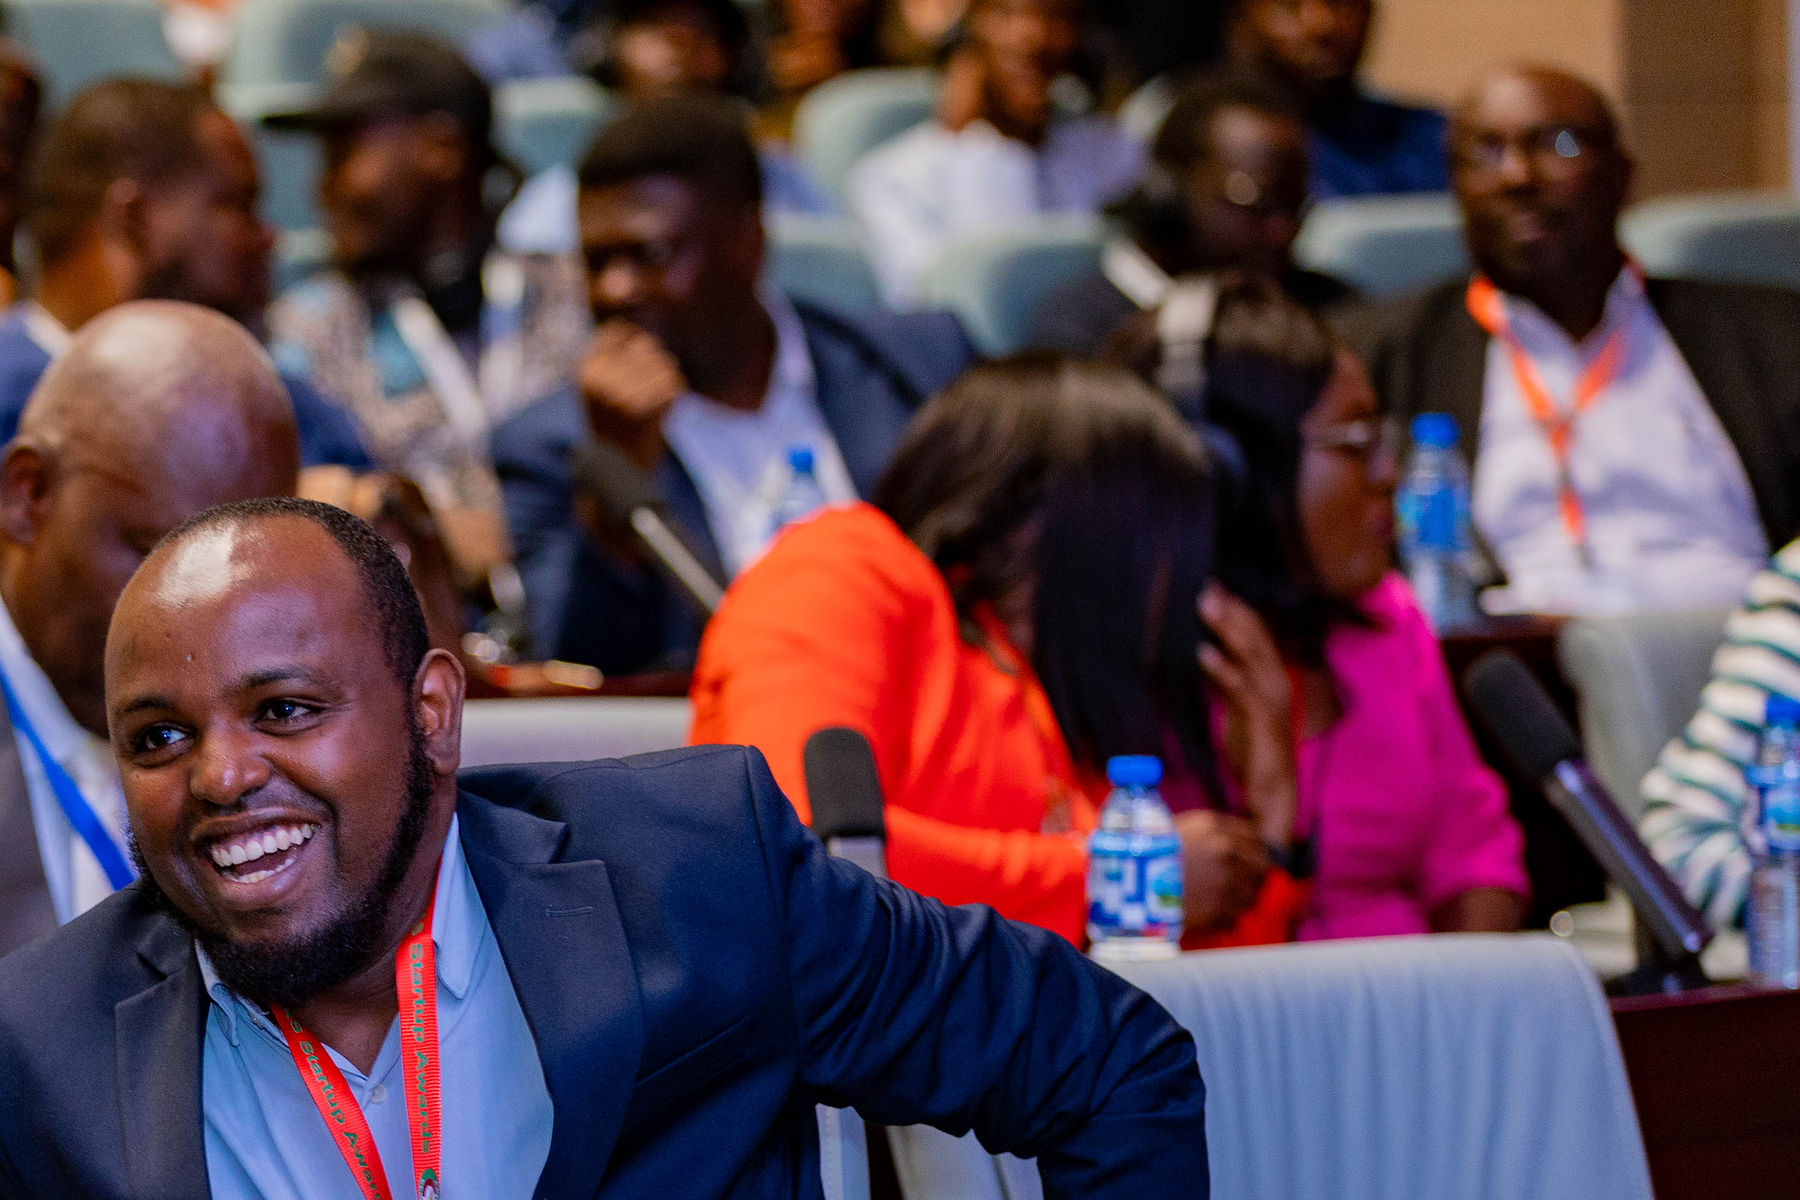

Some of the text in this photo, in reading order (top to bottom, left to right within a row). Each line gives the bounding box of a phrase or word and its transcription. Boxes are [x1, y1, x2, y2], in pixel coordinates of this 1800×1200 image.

[410, 943, 425, 1043] Startup
[300, 1040, 345, 1125] Startup
[416, 1051, 431, 1154] Awards
